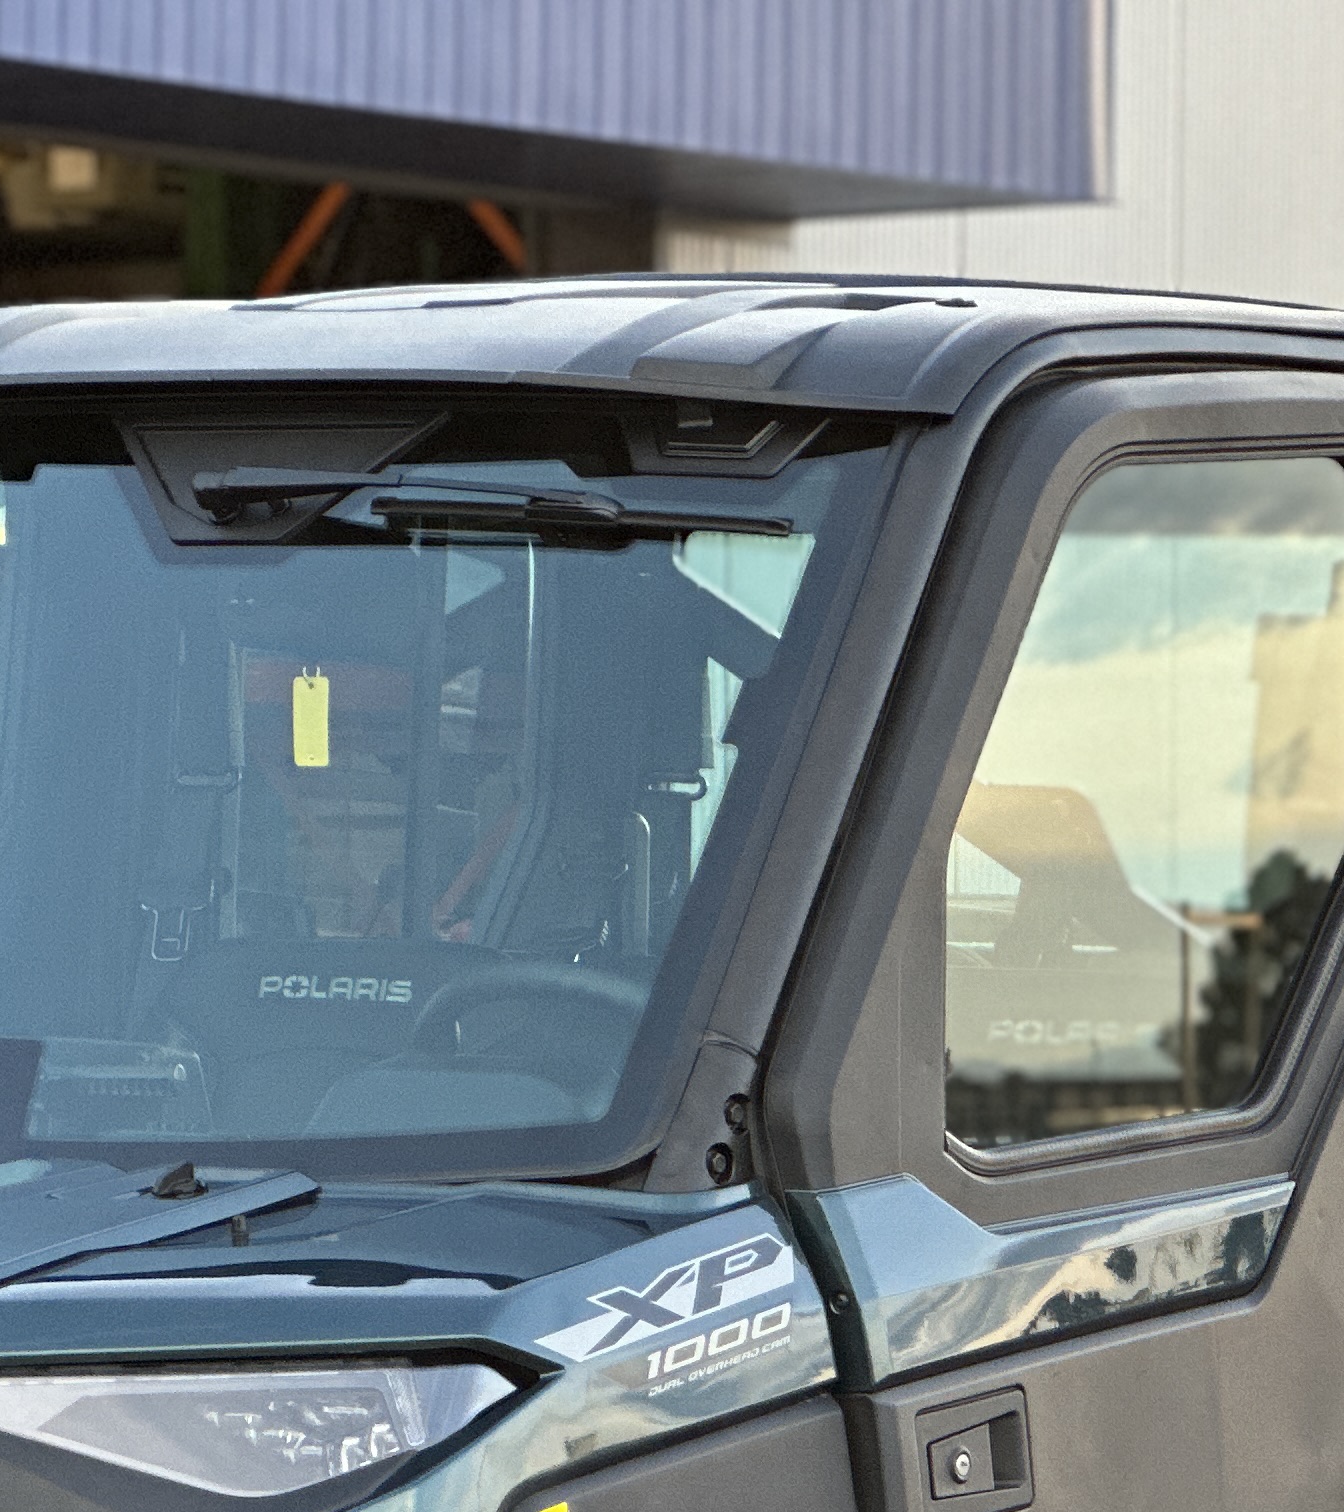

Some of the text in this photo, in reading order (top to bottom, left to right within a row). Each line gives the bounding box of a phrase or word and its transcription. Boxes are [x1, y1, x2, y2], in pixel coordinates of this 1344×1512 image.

[258, 974, 413, 1003] POLARIS
[584, 1236, 784, 1357] XP
[647, 1302, 792, 1380] 1000
[647, 1334, 791, 1397] DUAL OVERHEAD CAM
